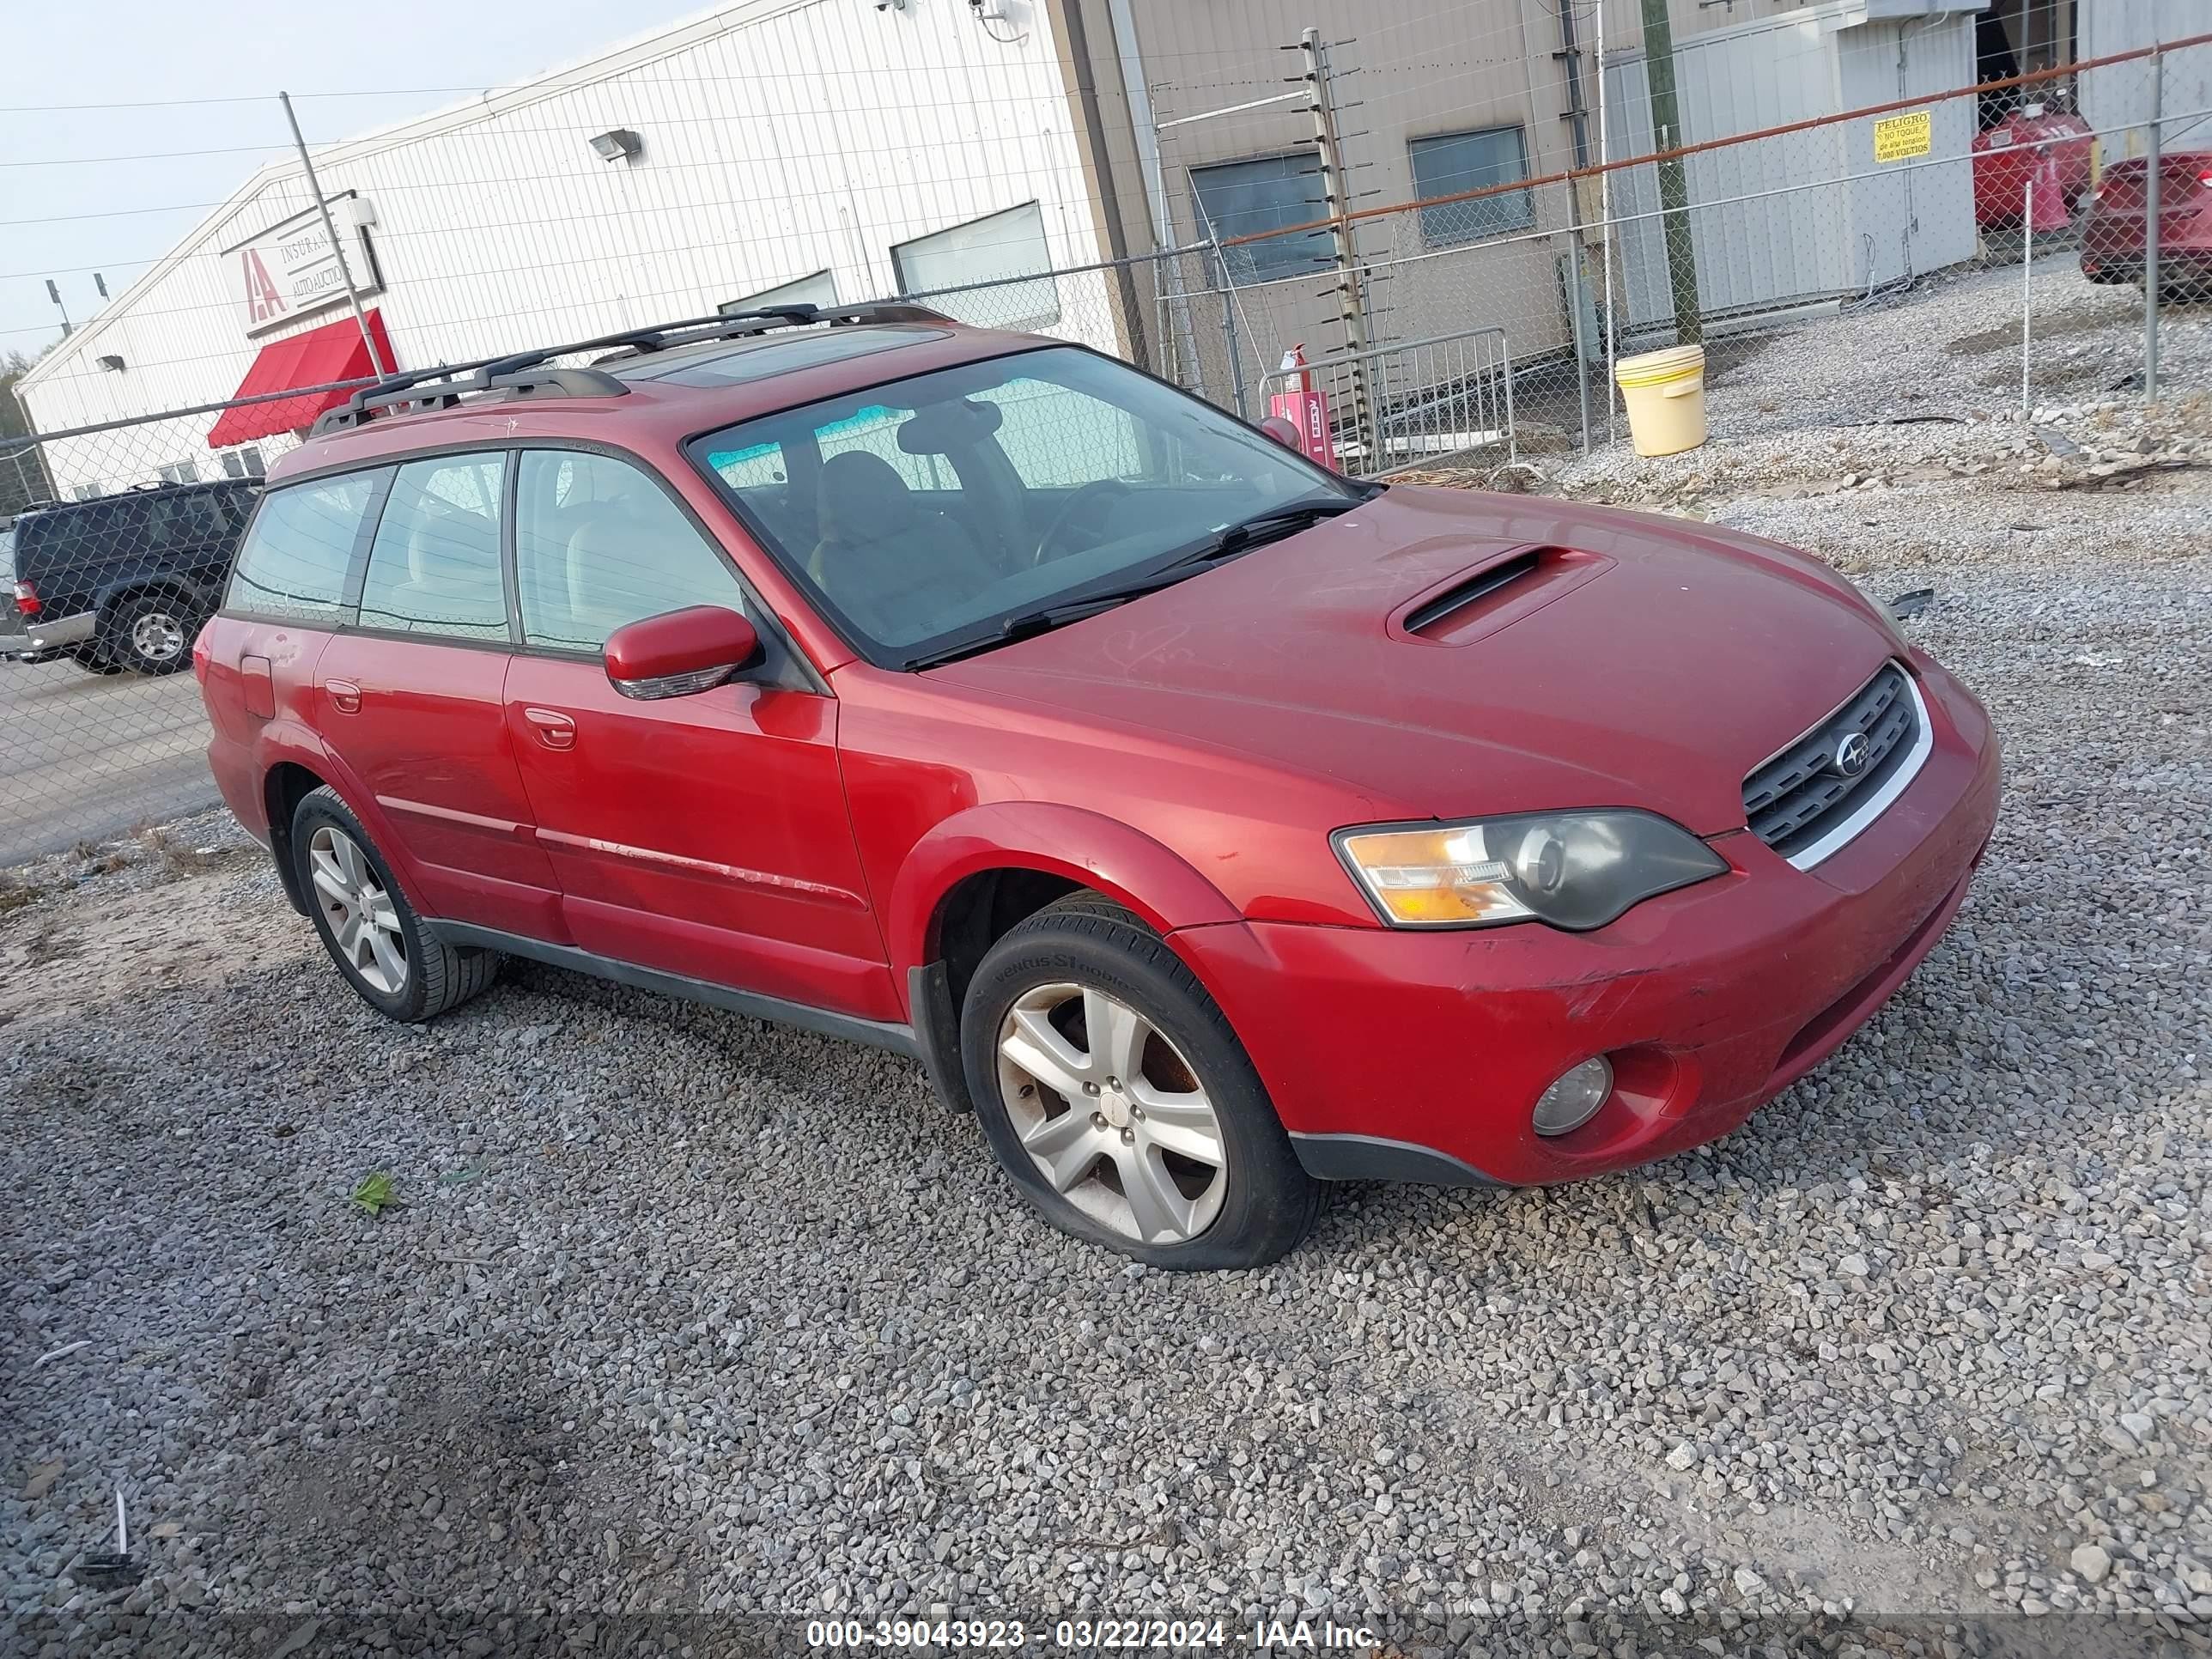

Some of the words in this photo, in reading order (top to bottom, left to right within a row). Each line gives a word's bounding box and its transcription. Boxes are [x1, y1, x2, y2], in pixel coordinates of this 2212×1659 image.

[1877, 113, 1928, 131] PELIGRO
[1877, 150, 1894, 161] 7,000
[1895, 144, 1929, 156] VOLTIOS
[281, 223, 343, 264] INSURANE
[292, 276, 313, 298] AUTO
[314, 261, 353, 290] AUCTIOS
[1311, 408, 1320, 436] FIRE
[1054, 953, 1077, 969] S1
